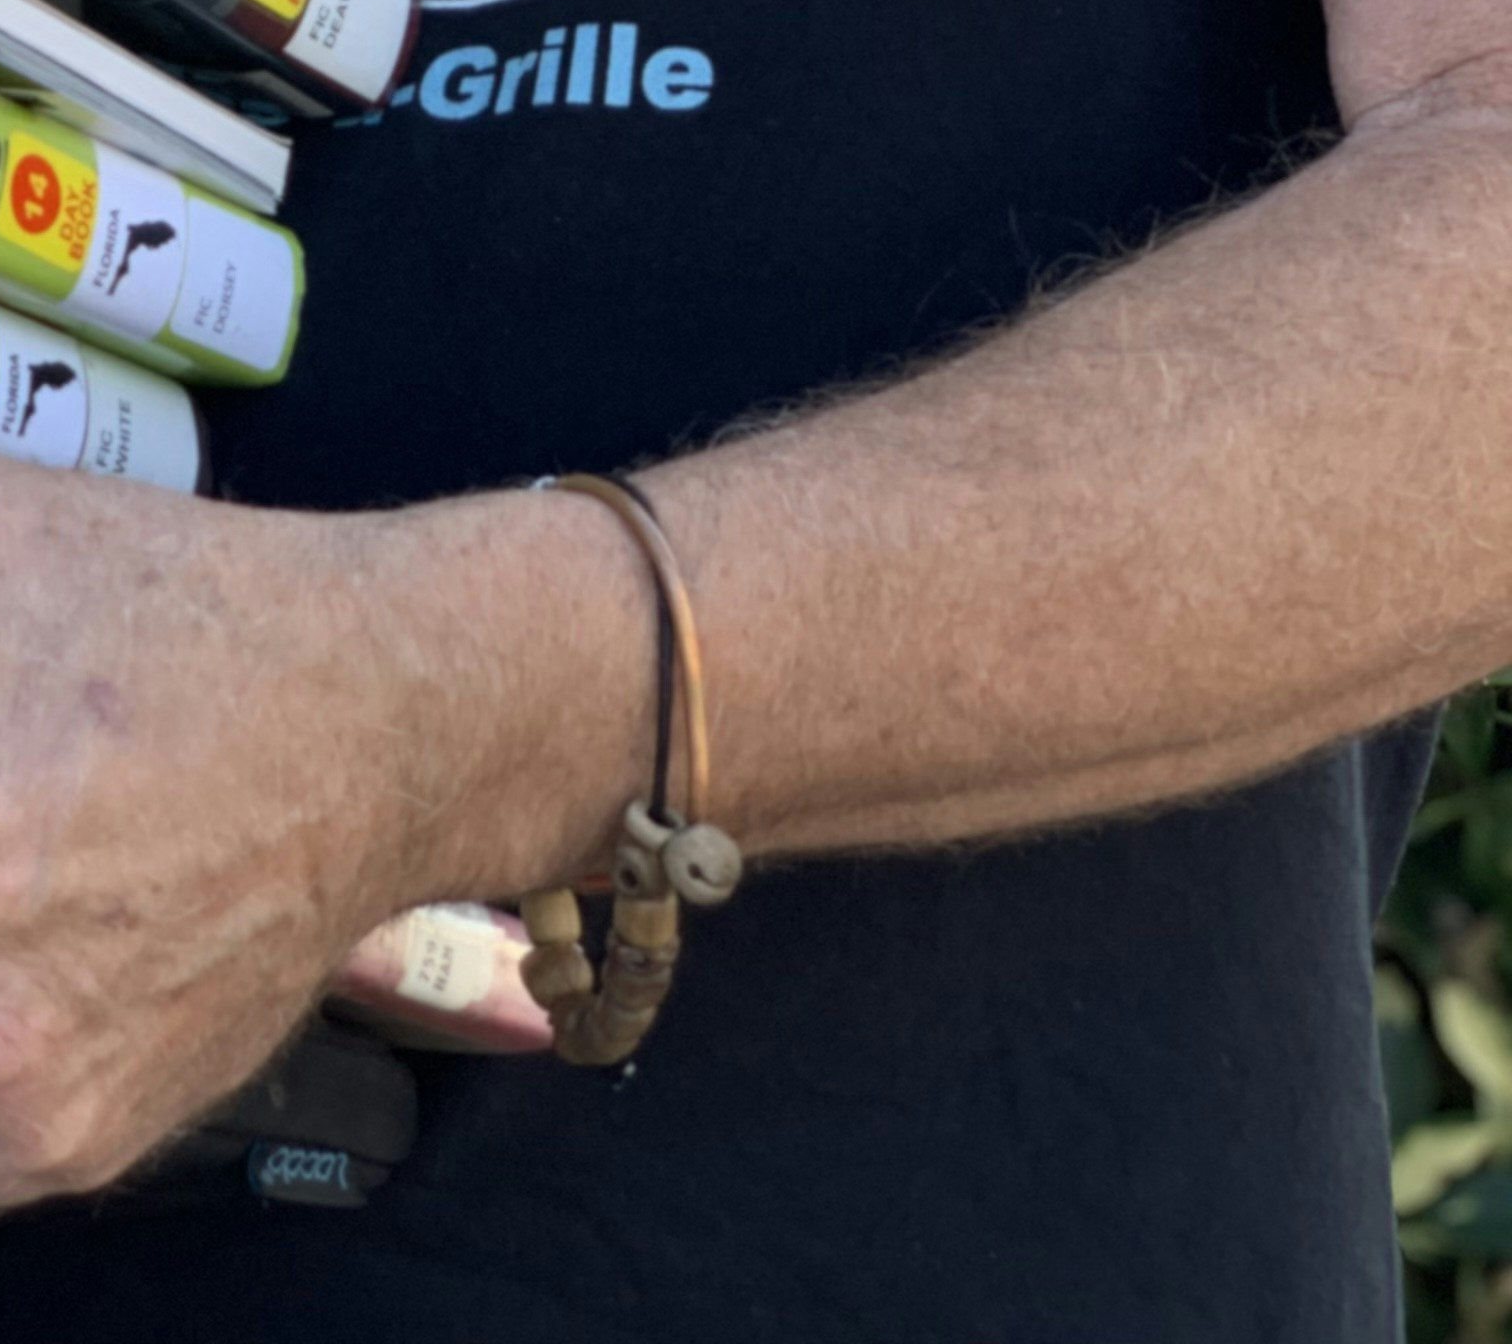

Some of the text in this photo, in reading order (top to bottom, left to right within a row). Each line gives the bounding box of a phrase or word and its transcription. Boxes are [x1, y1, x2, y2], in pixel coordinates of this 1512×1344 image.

[308, 4, 331, 42] FIC
[391, 21, 715, 121] -Grille
[23, 171, 50, 221] 14
[59, 184, 82, 242] DAY
[67, 177, 98, 261] BOOK
[92, 208, 121, 288] FLORIDA
[193, 295, 212, 327] FIC
[212, 260, 237, 335] DORSEY
[0, 352, 20, 435] FLORIDA
[96, 429, 114, 469] FIC
[112, 397, 133, 474] WHITE
